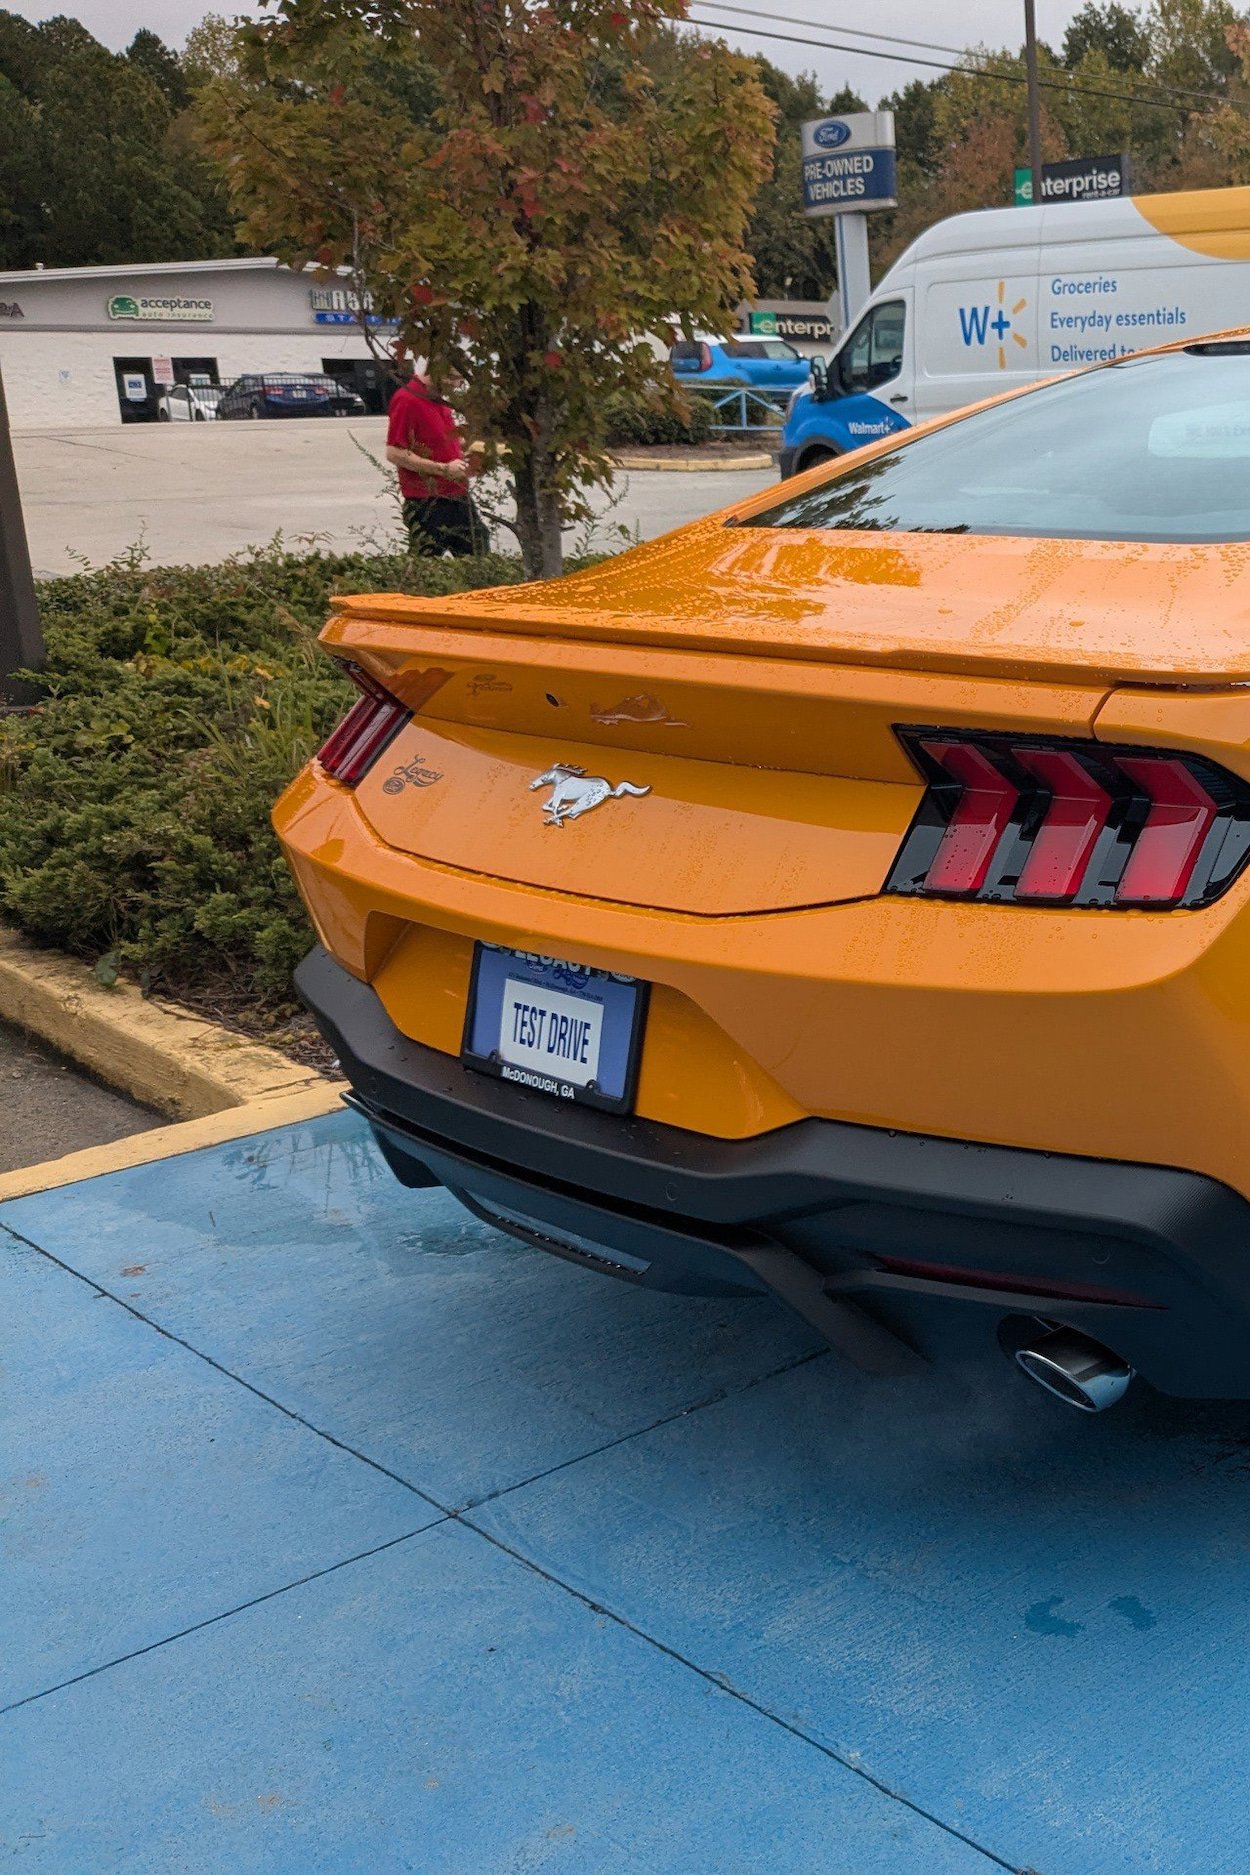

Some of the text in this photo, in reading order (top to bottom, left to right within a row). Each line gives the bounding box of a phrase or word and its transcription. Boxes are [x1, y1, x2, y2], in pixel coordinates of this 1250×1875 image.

[804, 155, 874, 180] PRE-OWNED
[809, 176, 865, 200] VEHICLES
[1051, 276, 1118, 296] Groceries
[141, 299, 212, 311] acceptance
[959, 305, 1011, 347] W+
[1050, 306, 1187, 333] Everyday essentials
[1051, 345, 1117, 363] Delivered
[394, 754, 444, 787] Legacy
[513, 1002, 592, 1064] TEST DRIVE
[502, 1066, 575, 1100] McDONOUGH, GA
